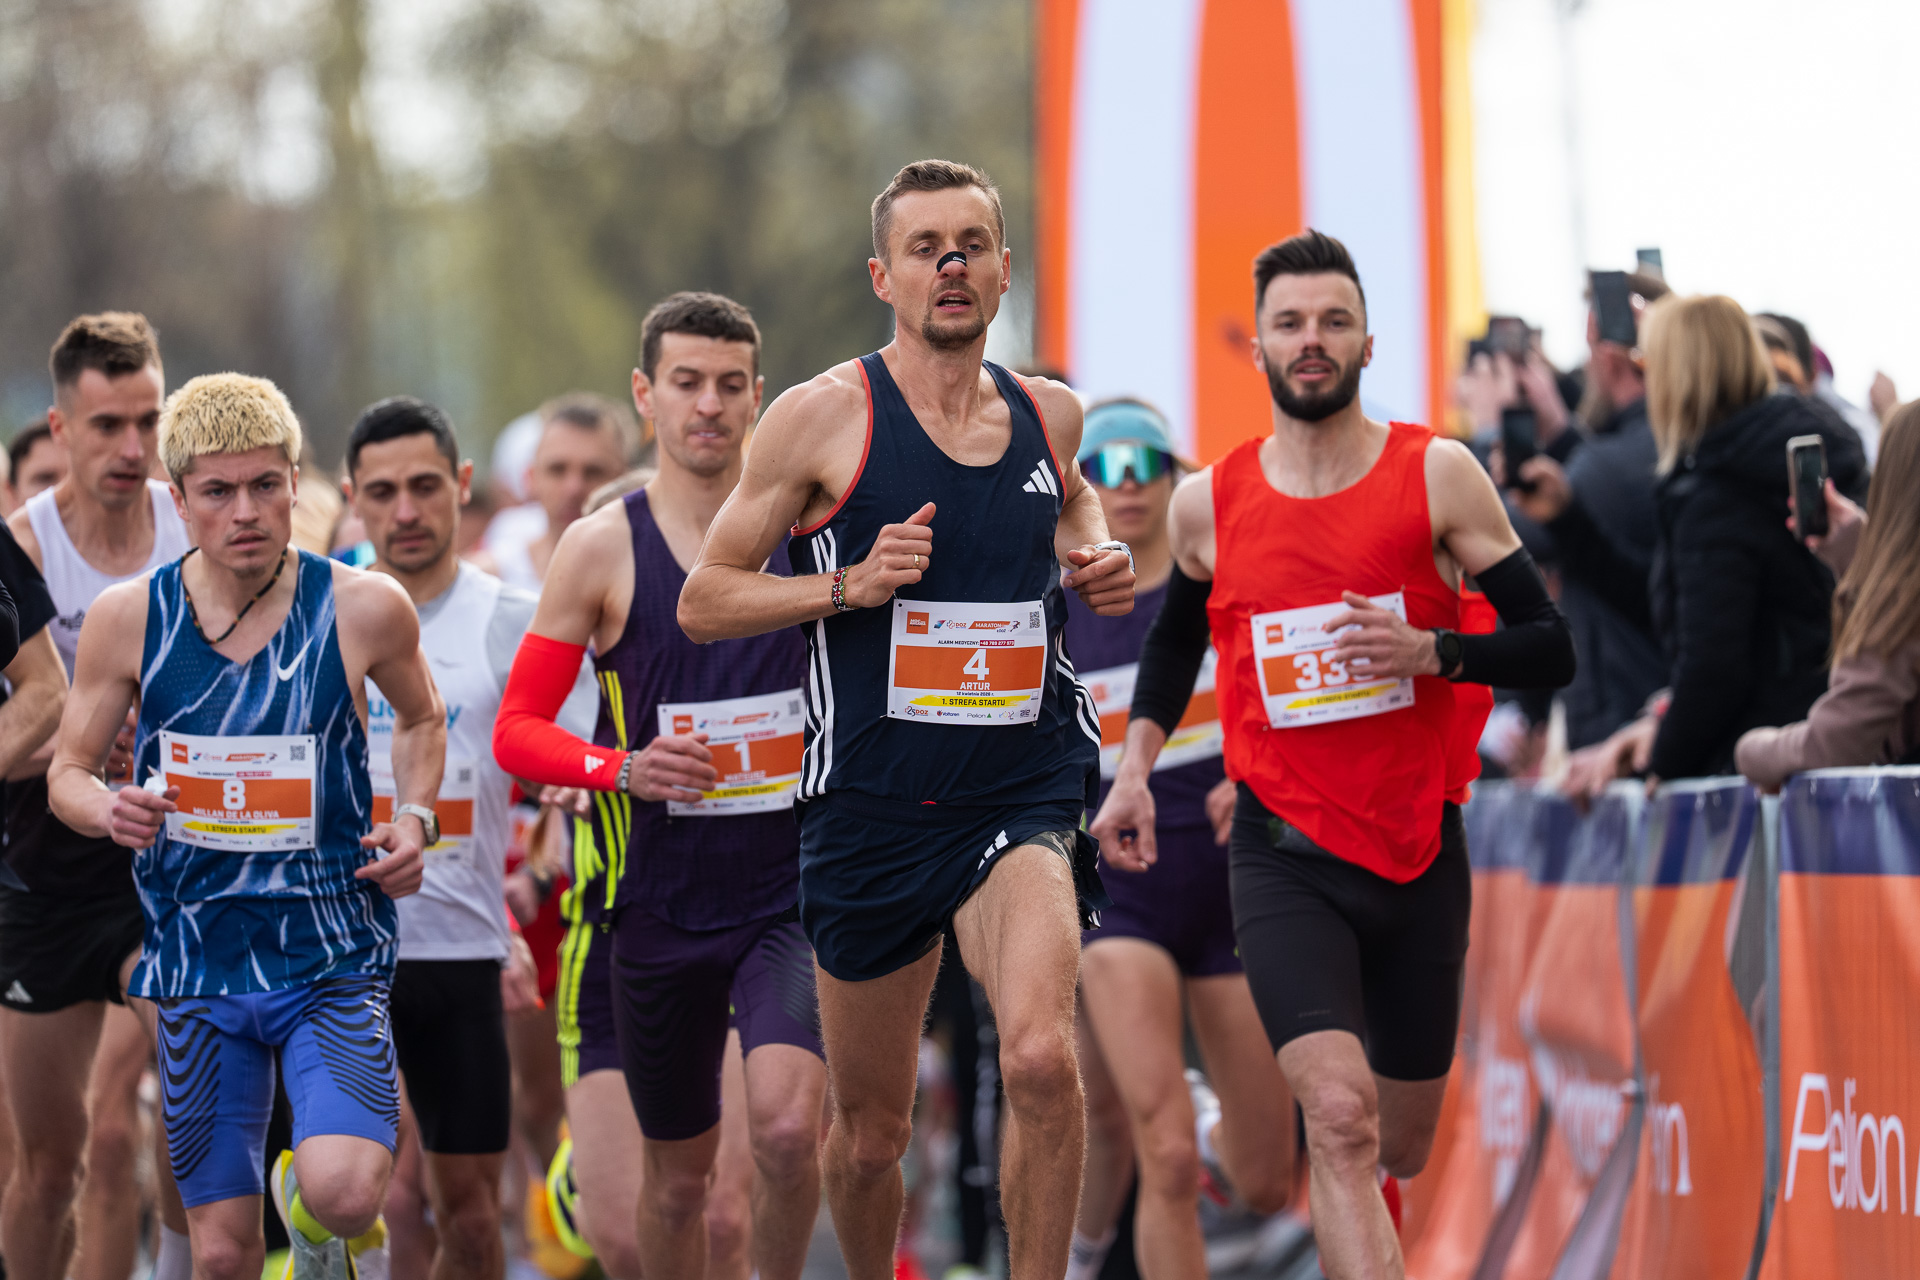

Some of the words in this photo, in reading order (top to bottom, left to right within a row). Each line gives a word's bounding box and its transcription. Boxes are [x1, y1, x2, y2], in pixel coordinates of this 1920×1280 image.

[962, 648, 990, 681] 4
[959, 681, 991, 691] ARTUR
[948, 698, 977, 706] STREFA
[978, 698, 1006, 706] STARTU
[734, 742, 751, 772] 1
[222, 779, 246, 810] 8
[192, 807, 225, 819] MILLAN
[225, 809, 238, 819] DE
[239, 810, 252, 820] LA
[252, 810, 280, 820] OLIVA
[211, 825, 238, 833] STREFA
[239, 826, 267, 834] STARTU
[1784, 1071, 1908, 1214] Pelion
